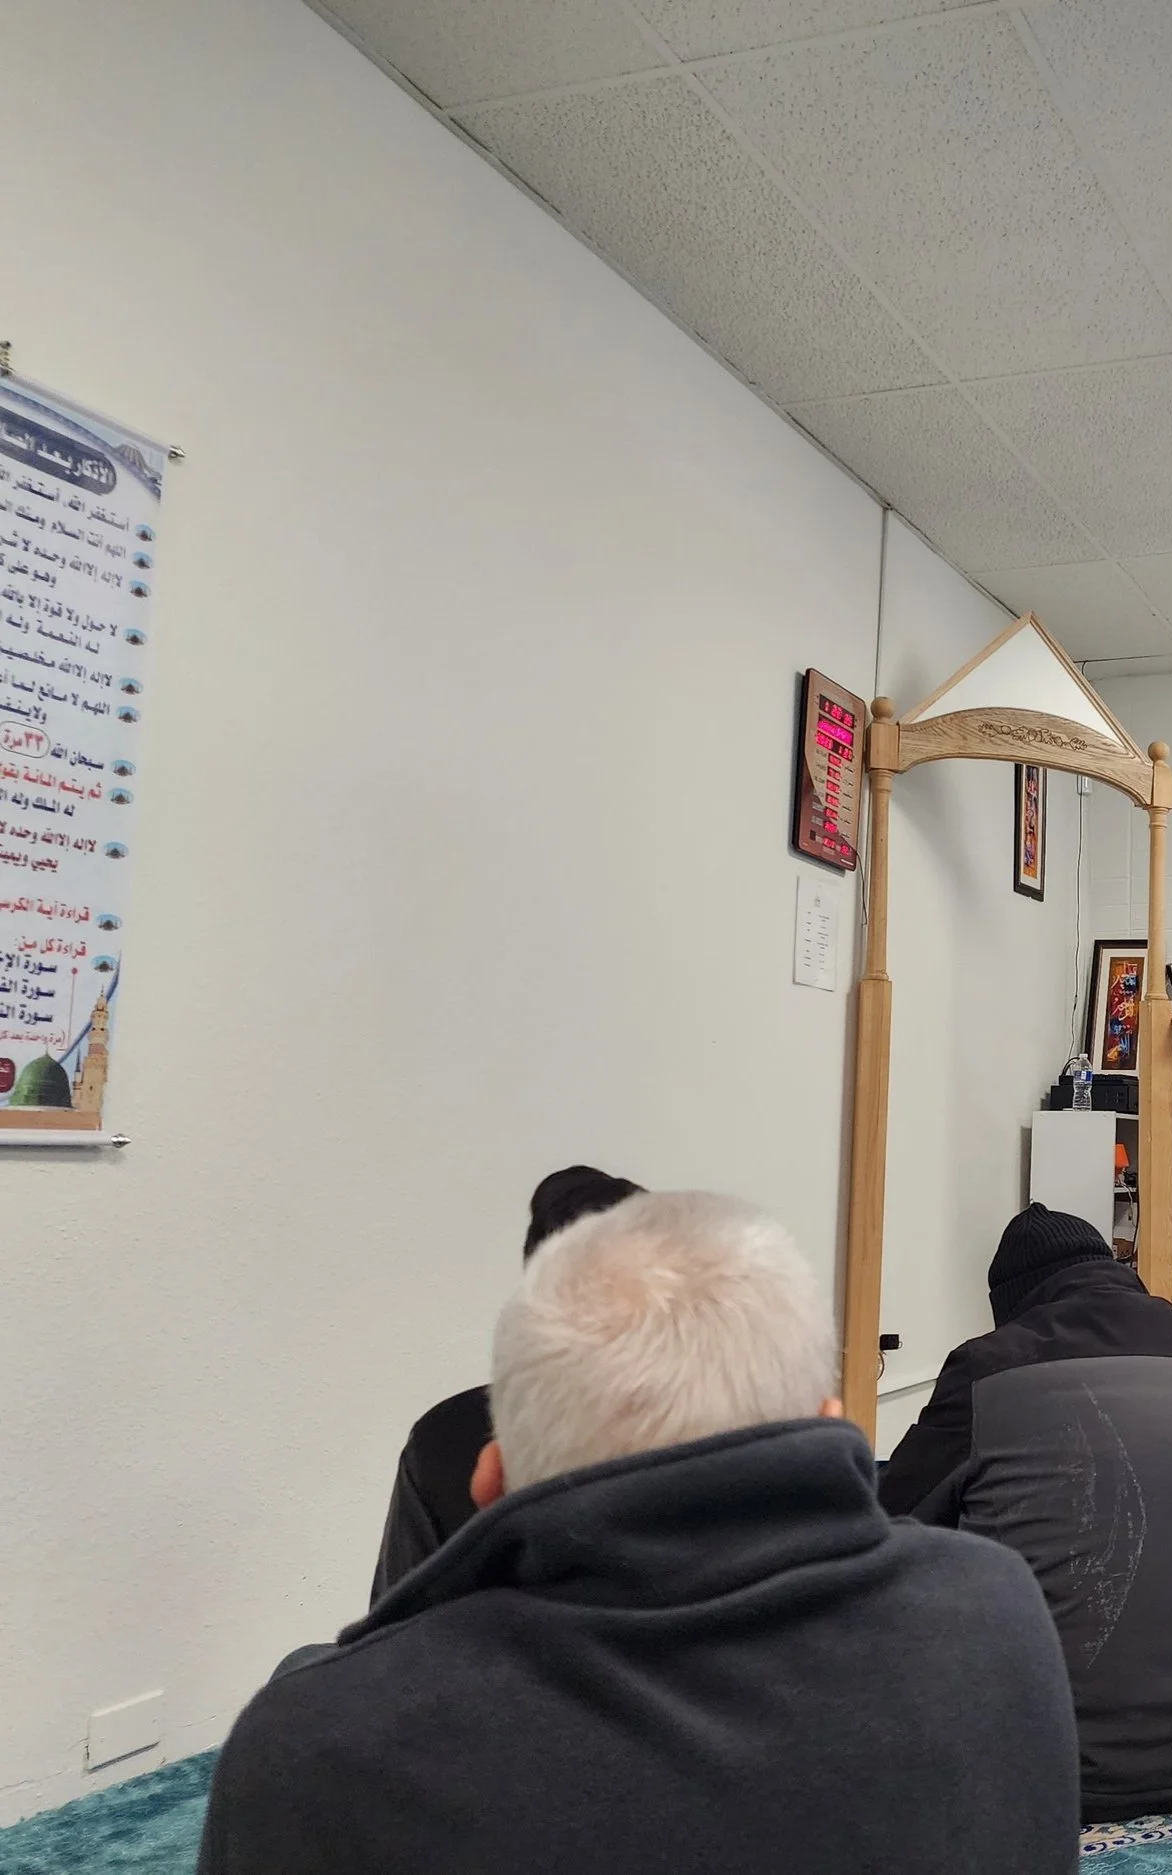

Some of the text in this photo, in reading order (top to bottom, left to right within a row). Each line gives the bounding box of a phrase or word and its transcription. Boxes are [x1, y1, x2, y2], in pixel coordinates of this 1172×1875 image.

[81, 614, 106, 632] حول
[110, 623, 118, 637] لا
[85, 640, 100, 655] له
[71, 692, 80, 706] لا
[81, 700, 110, 716] اللهم
[50, 743, 68, 759] الله
[69, 751, 105, 771] سبحان
[87, 781, 102, 800] ثم
[11, 792, 29, 811] وله
[32, 796, 61, 814] الملك
[63, 803, 76, 818] له
[9, 825, 38, 845] وحده
[59, 903, 89, 924] قراءة
[40, 938, 55, 955] كل
[57, 938, 86, 960] قراءة
[23, 953, 57, 976] سورة
[21, 978, 55, 1000] سورة
[19, 1003, 53, 1026] سورة
